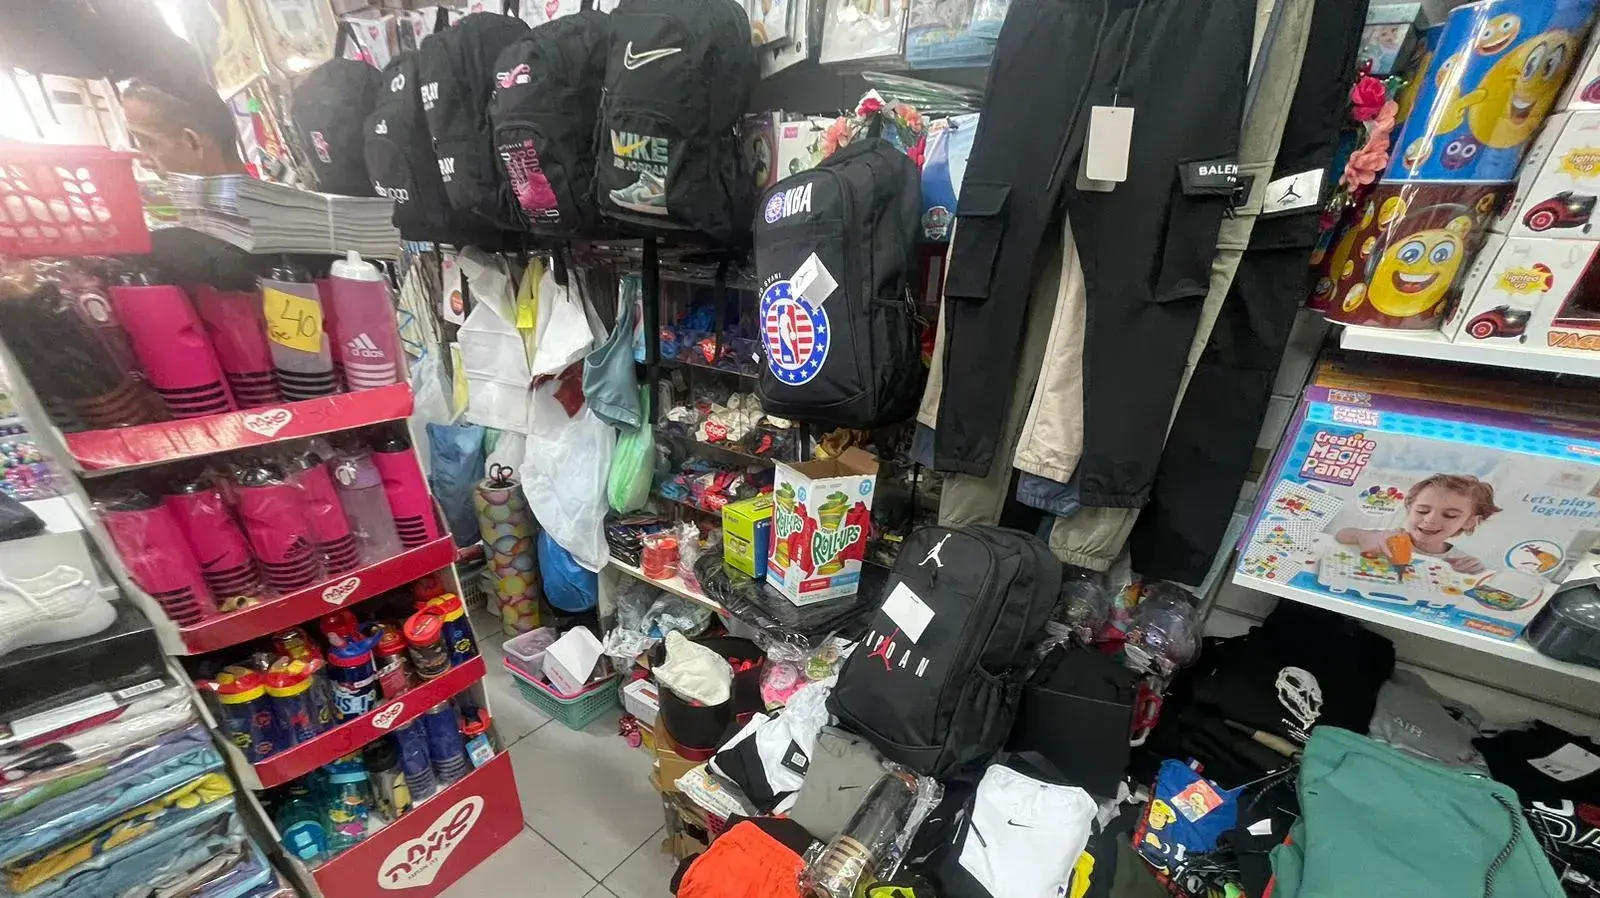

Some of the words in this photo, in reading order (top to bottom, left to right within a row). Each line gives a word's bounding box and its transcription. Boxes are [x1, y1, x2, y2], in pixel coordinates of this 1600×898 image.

[782, 182, 814, 218] NBA
[280, 299, 317, 338] 40
[1315, 431, 1376, 450] Creative
[1309, 441, 1370, 466] Magic
[1302, 457, 1361, 480] Panel
[1559, 497, 1596, 510] play
